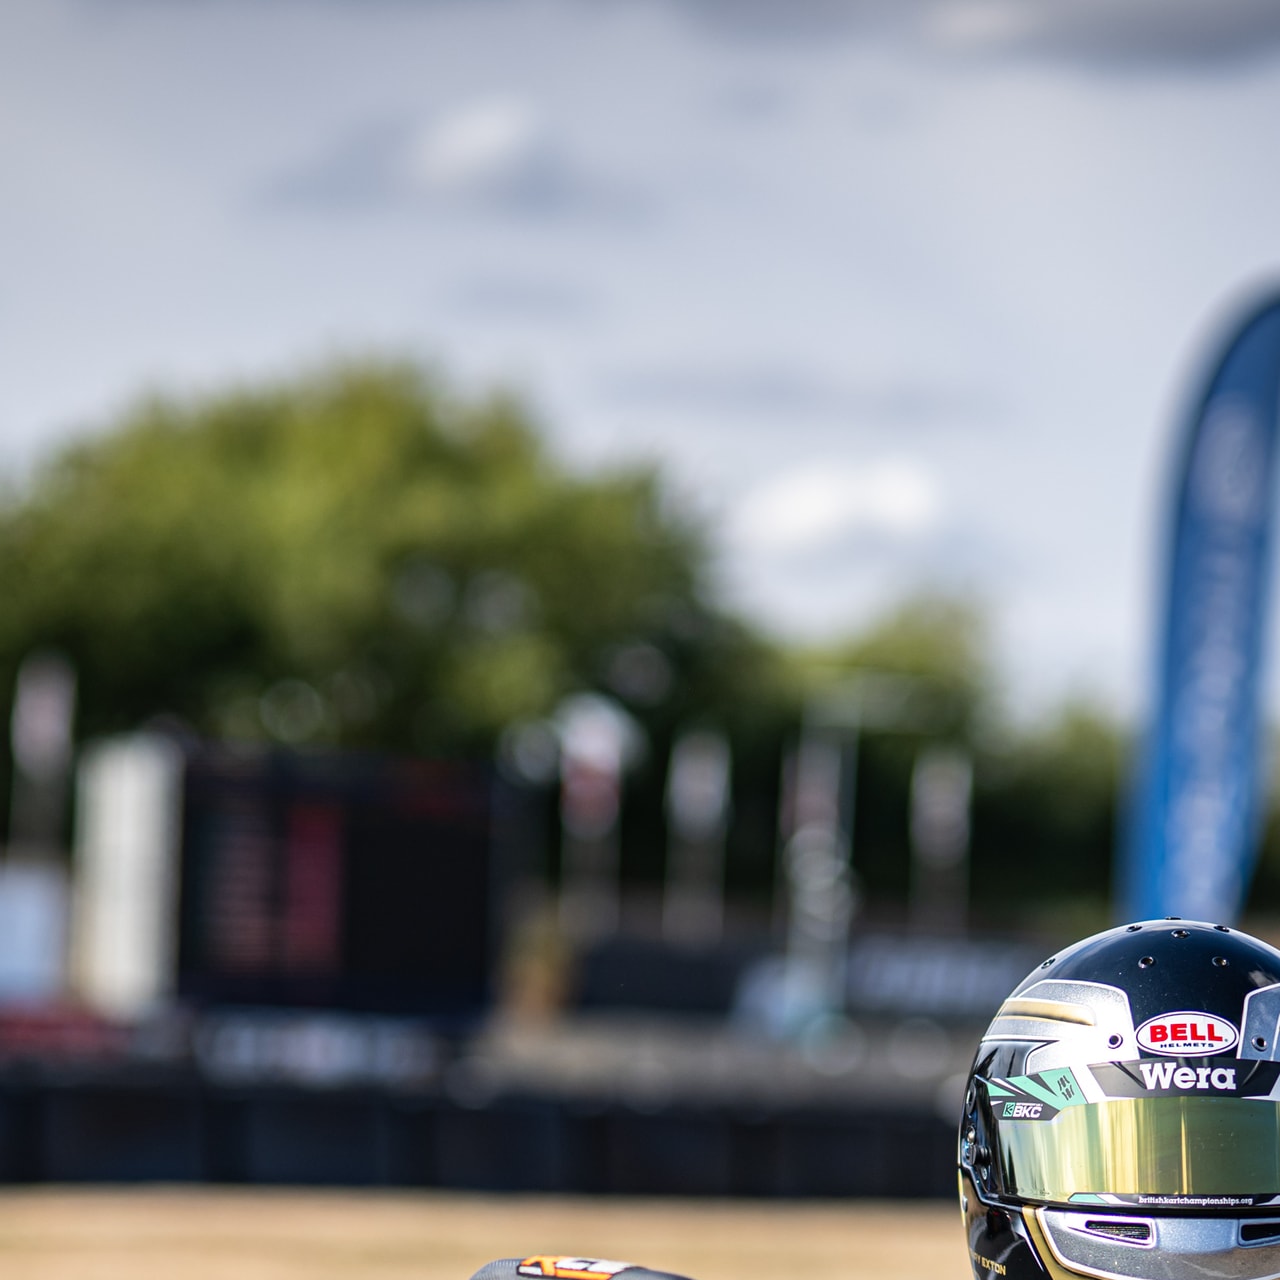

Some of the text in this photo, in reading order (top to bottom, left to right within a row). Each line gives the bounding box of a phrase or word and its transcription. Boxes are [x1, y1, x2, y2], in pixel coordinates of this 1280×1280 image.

[1150, 1022, 1223, 1043] BELL
[1160, 1041, 1215, 1049] HELMETS
[1139, 1062, 1237, 1090] Wera
[1137, 1196, 1254, 1207] britishkartchampionships.org
